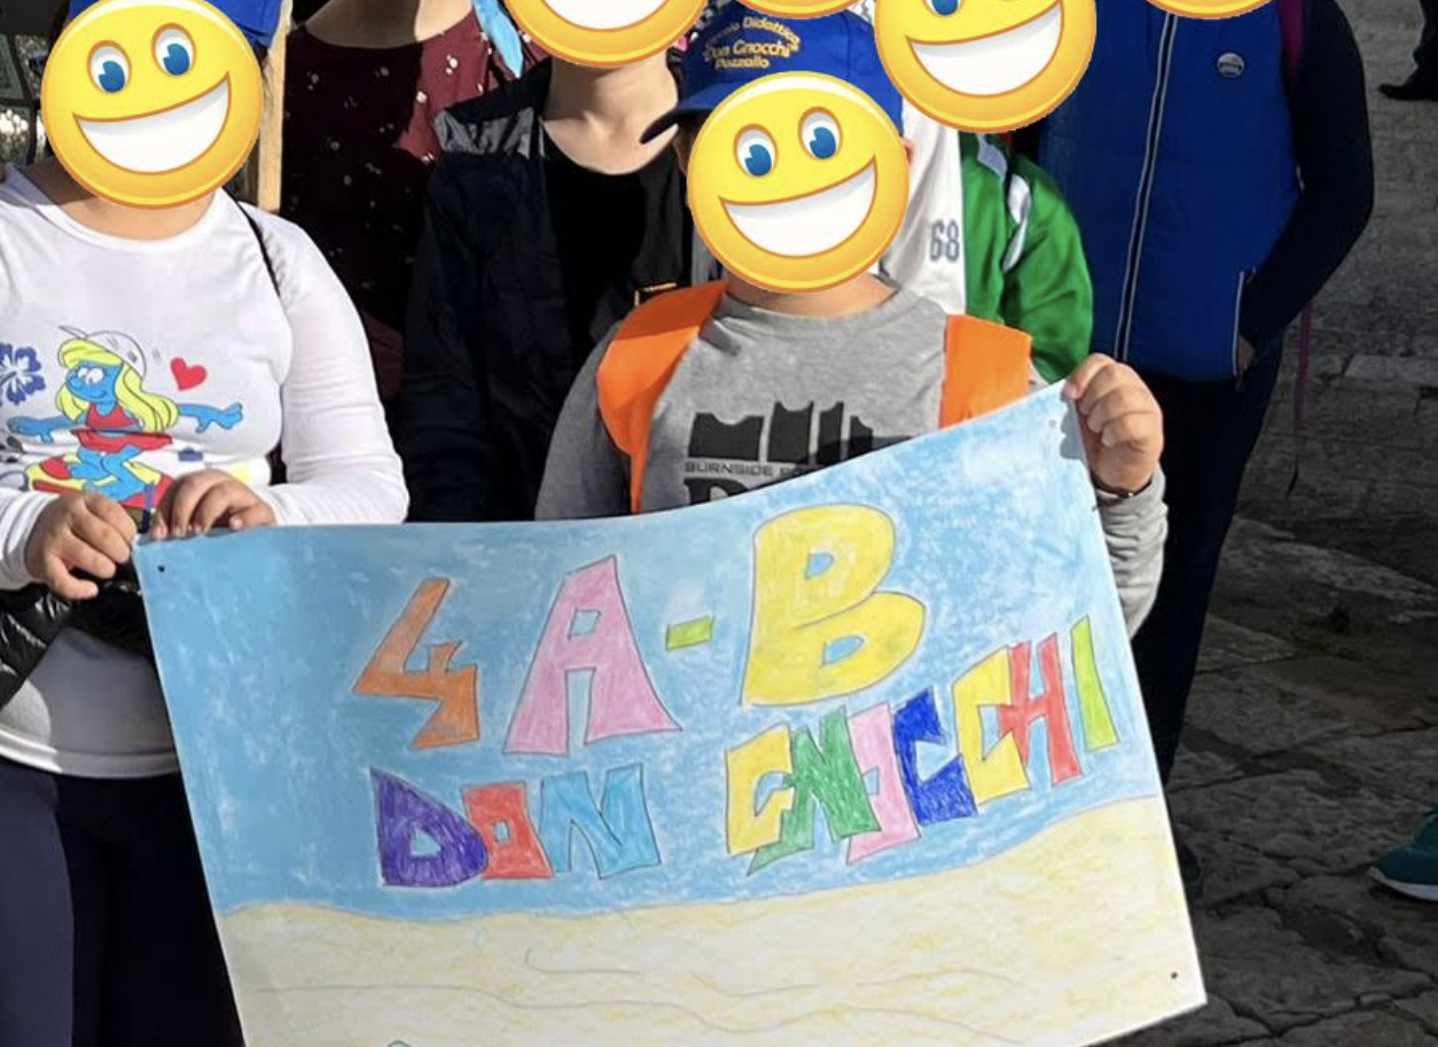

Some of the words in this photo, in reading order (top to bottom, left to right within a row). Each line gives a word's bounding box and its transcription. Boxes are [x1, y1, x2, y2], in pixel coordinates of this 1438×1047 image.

[931, 218, 960, 262] 68
[685, 461, 772, 476] BURNSIDE
[370, 764, 662, 888] DON
